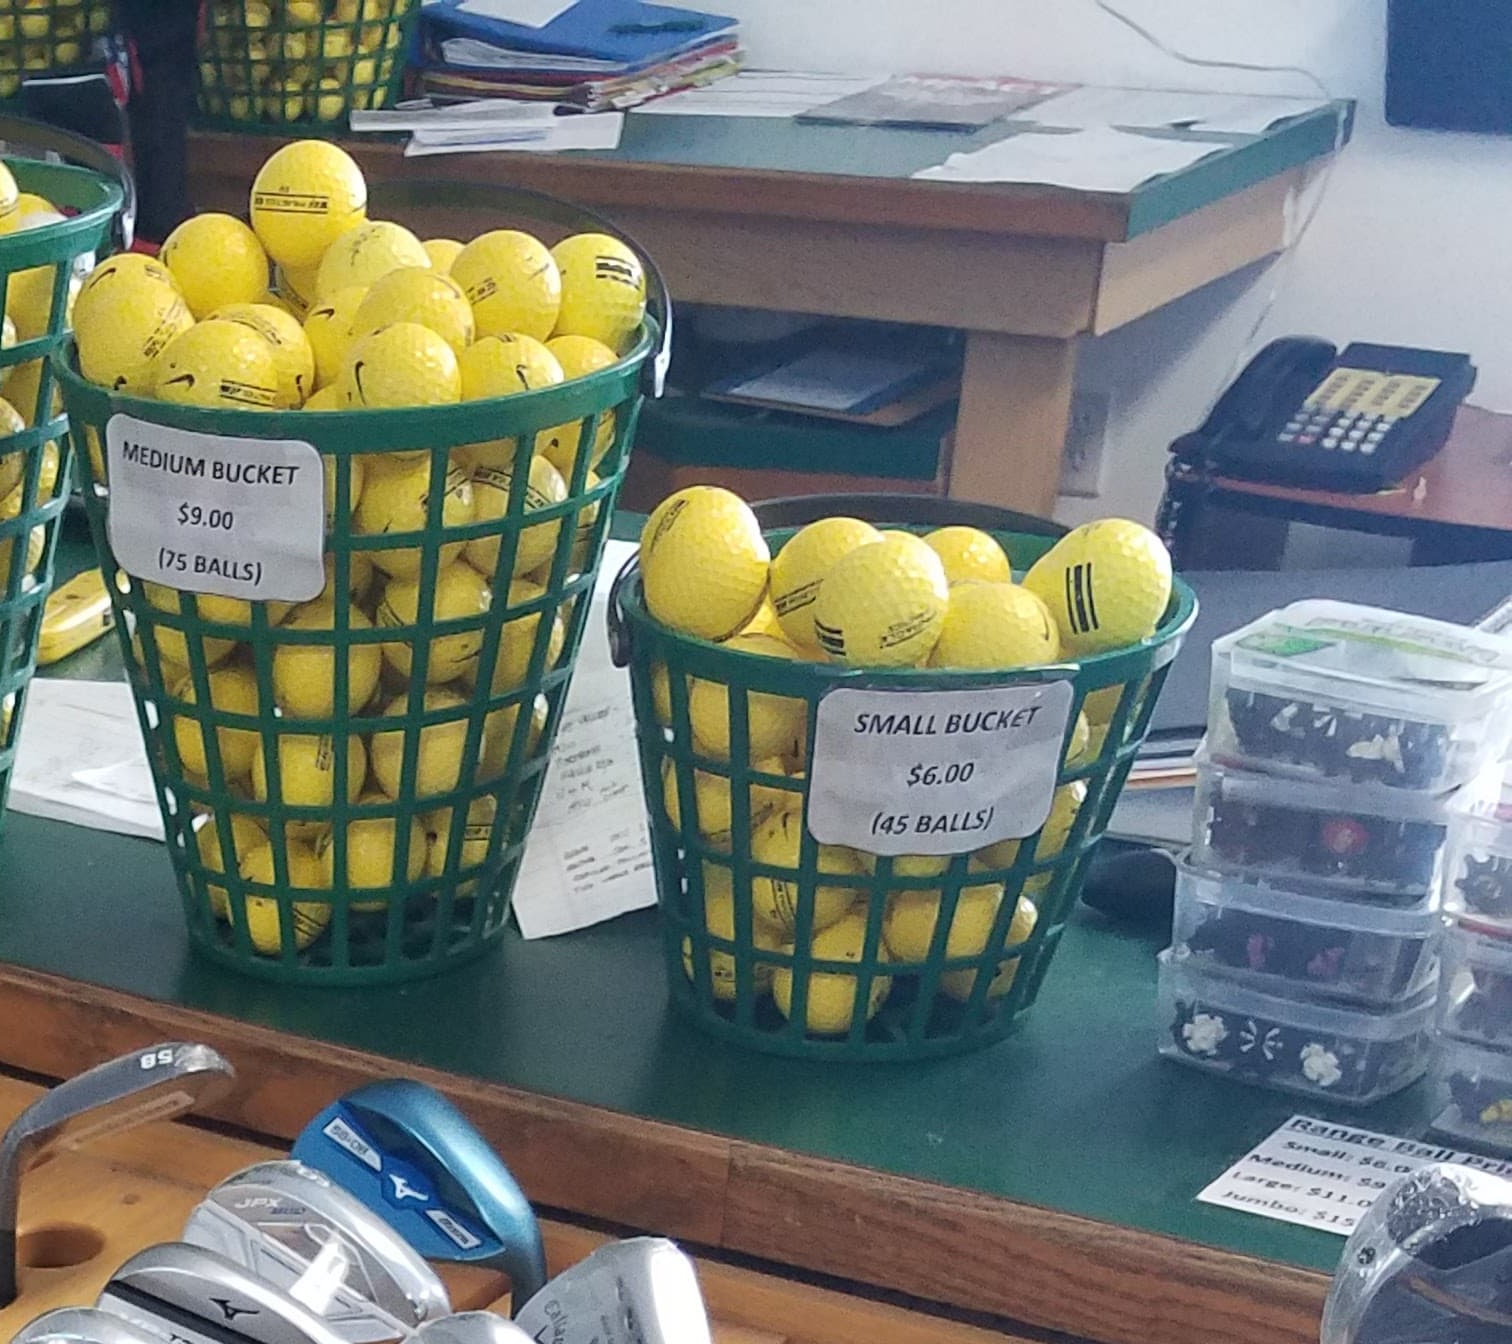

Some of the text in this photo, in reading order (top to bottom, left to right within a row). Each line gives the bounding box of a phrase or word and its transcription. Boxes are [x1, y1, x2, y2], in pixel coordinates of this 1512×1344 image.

[122, 439, 299, 487] MEDIUM BUCKET
[177, 503, 234, 531] $9.00
[158, 545, 262, 587] (75 BALLS)
[853, 703, 1042, 737] SMALL BUCKET
[906, 760, 975, 787] $6.00
[871, 804, 994, 838] (45 BALLS)
[1284, 1140, 1413, 1174] Small: $6.0
[1290, 1118, 1512, 1178] Range Ball Pri
[1248, 1152, 1350, 1180] Medium:
[1221, 1189, 1306, 1214] Jumbo:
[1306, 1184, 1373, 1208] $11.0
